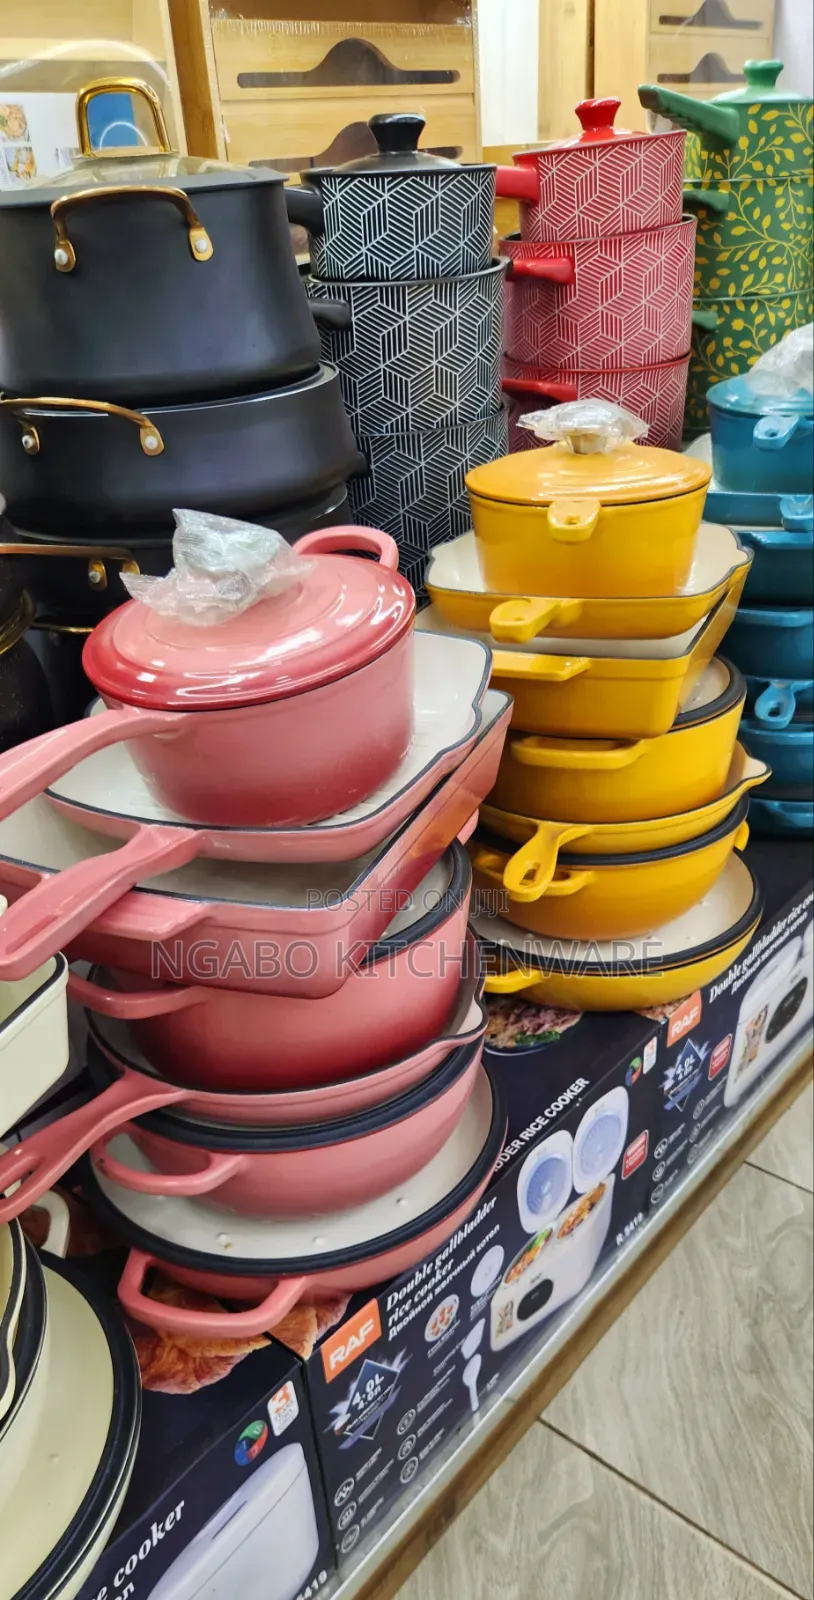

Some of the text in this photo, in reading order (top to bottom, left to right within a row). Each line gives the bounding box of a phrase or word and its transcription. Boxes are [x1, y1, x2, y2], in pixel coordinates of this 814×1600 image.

[709, 963, 741, 1004] Double
[671, 1005, 699, 1038] RAF
[494, 1077, 590, 1172] DDER RICE COOKER
[386, 1261, 434, 1312] Double
[434, 1196, 497, 1271] gallbladder
[388, 1299, 412, 1328] rice
[414, 1258, 454, 1303] cooker
[329, 1317, 375, 1371] RAF
[113, 1500, 185, 1588] cooker
